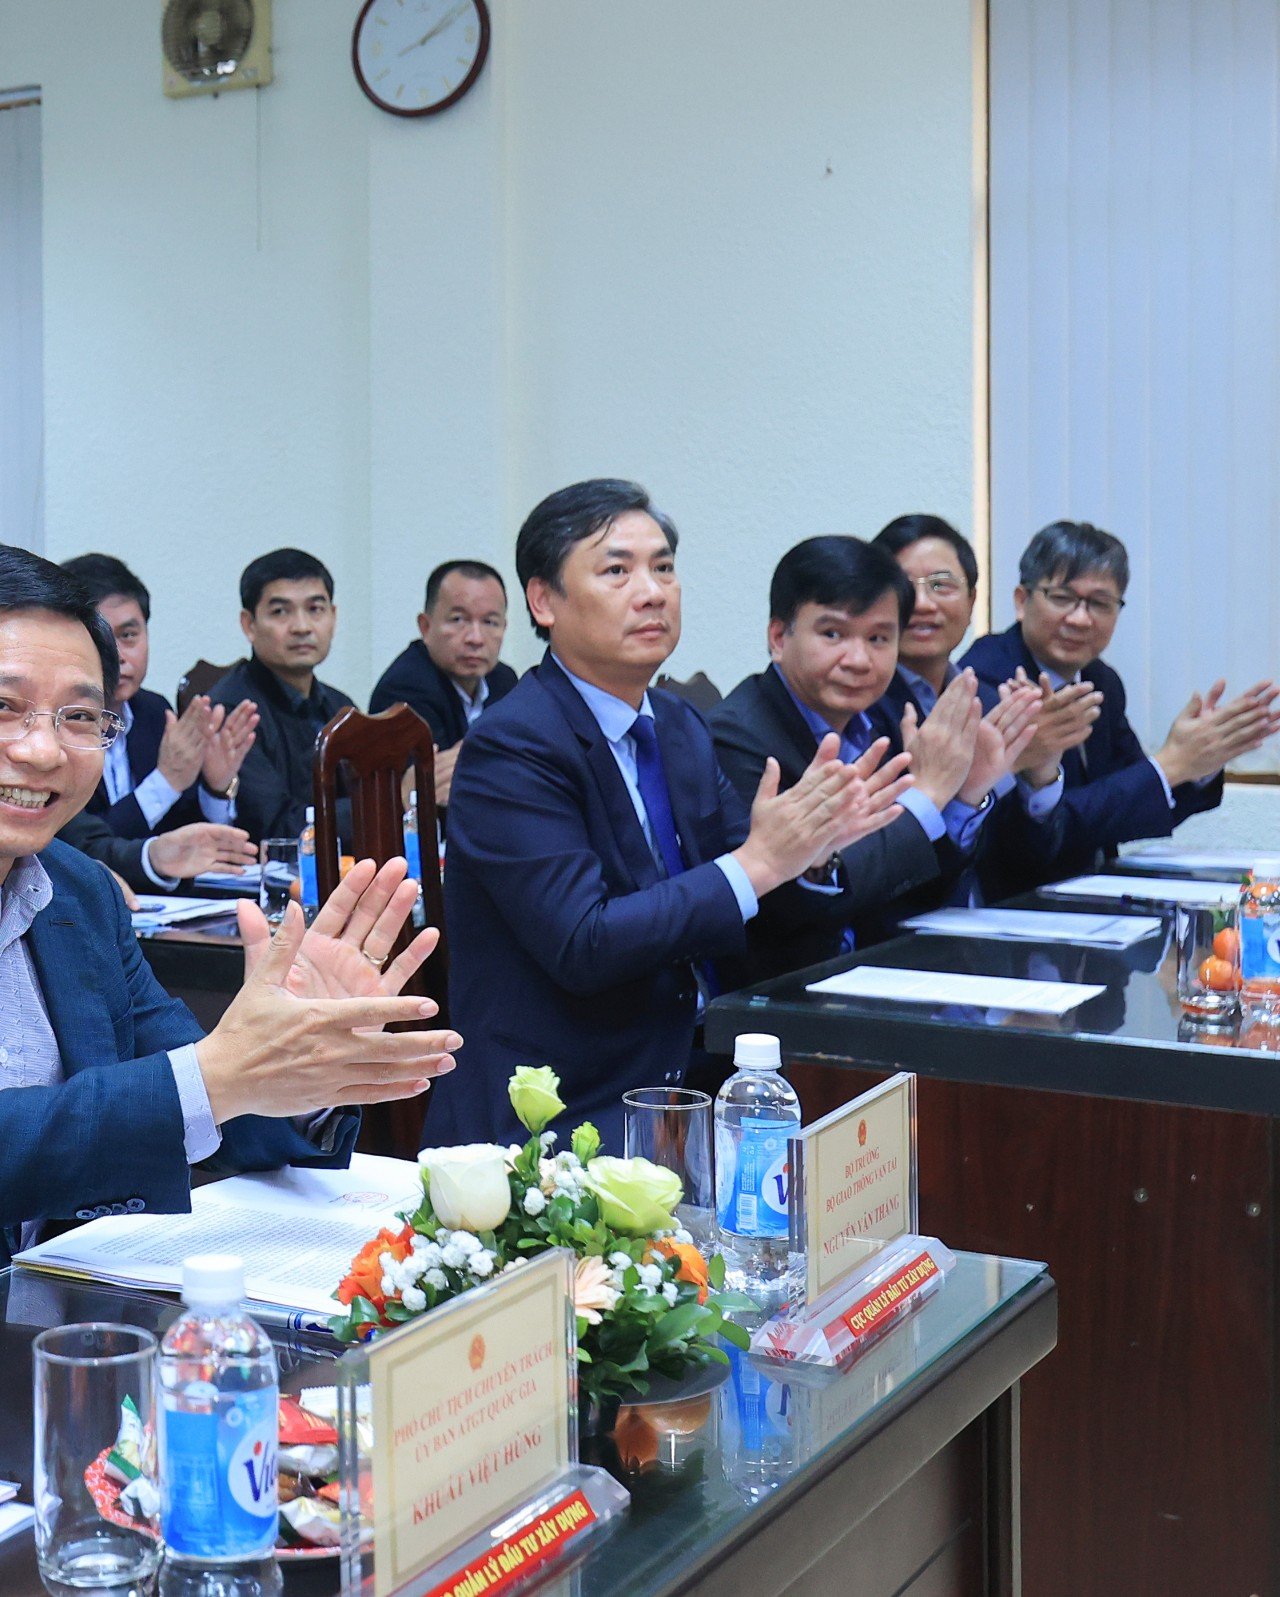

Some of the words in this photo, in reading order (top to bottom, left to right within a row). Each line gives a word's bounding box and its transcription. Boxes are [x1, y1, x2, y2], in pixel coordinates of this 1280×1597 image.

[836, 1185, 852, 1206] GIAO
[850, 1311, 867, 1330] CỤC
[863, 1299, 883, 1321] QUẢN
[878, 1290, 890, 1308] LÝ
[907, 1269, 920, 1287] XÂY
[916, 1257, 935, 1277] DỰNG
[453, 1569, 489, 1597] QUẢN
[483, 1555, 502, 1584] LÝ
[497, 1542, 524, 1573] ĐẦU
[520, 1532, 540, 1557] TƯ
[535, 1519, 560, 1547] XÂY
[555, 1500, 589, 1531] DỰNG
